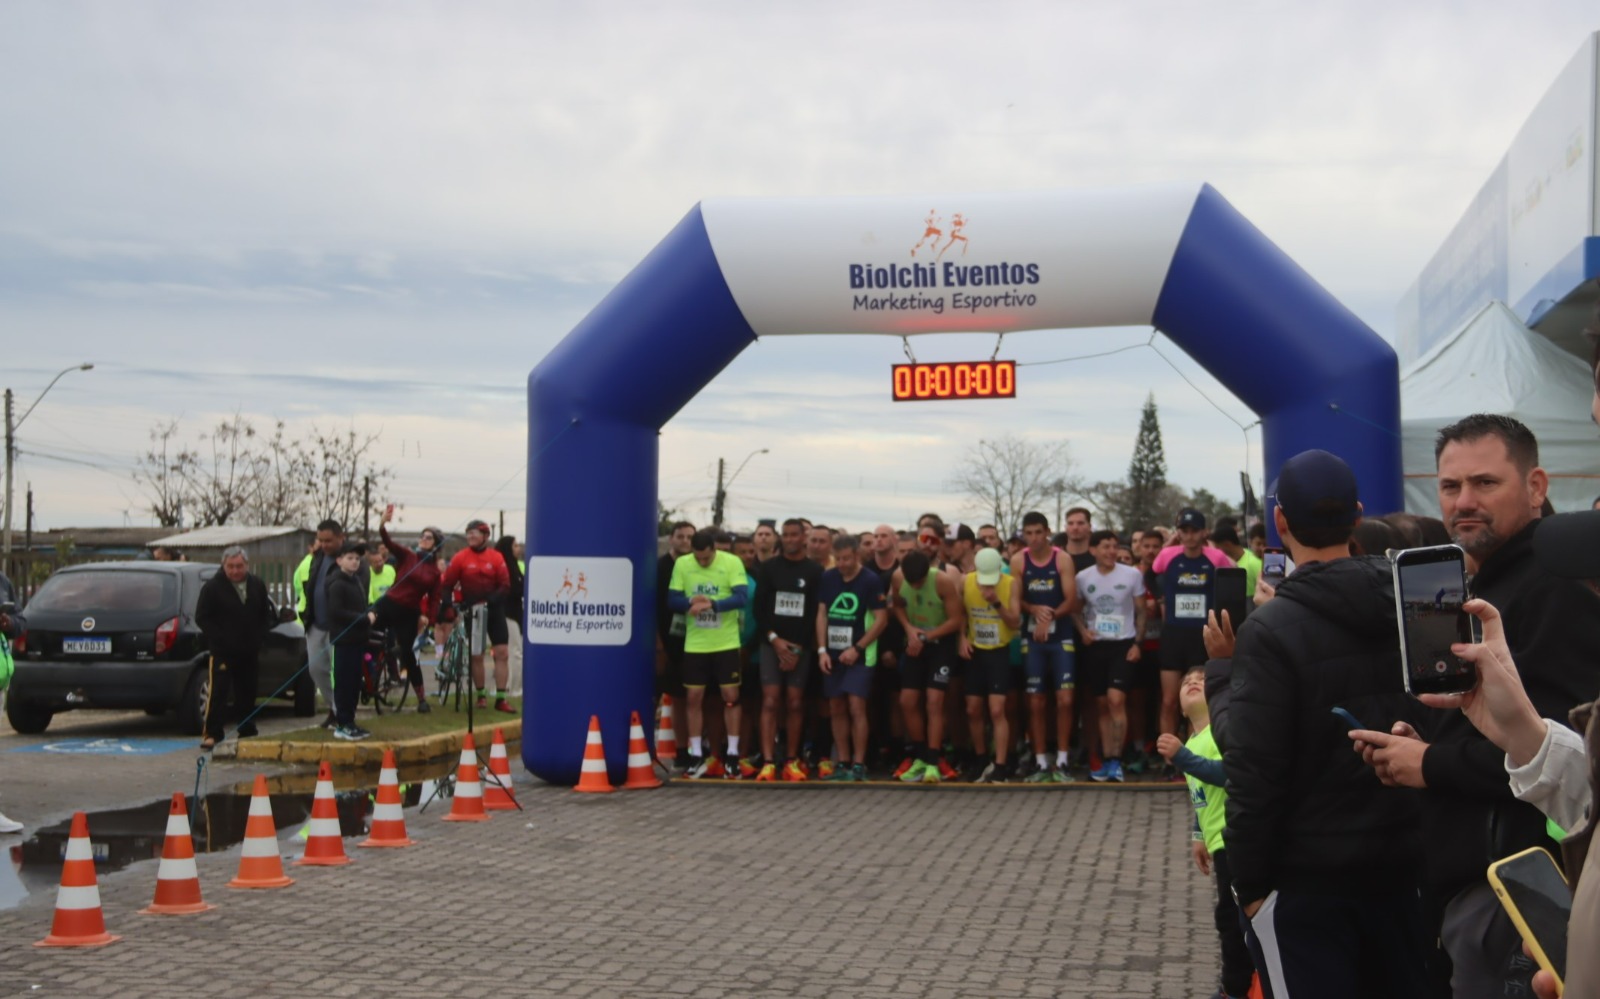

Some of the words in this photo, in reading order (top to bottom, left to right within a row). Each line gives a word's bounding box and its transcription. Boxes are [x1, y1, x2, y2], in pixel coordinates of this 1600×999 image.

[849, 262, 937, 289] Biolchi
[943, 261, 1040, 287] Eventos
[853, 292, 945, 314] Marketing
[952, 289, 1037, 313] Esportivo
[894, 363, 1014, 398] 00:00:00
[531, 600, 569, 615] Biolchi
[572, 601, 626, 616] Eventos
[1181, 602, 1200, 610] 3037
[531, 617, 572, 633] Marketing
[576, 618, 624, 634] Esportivo
